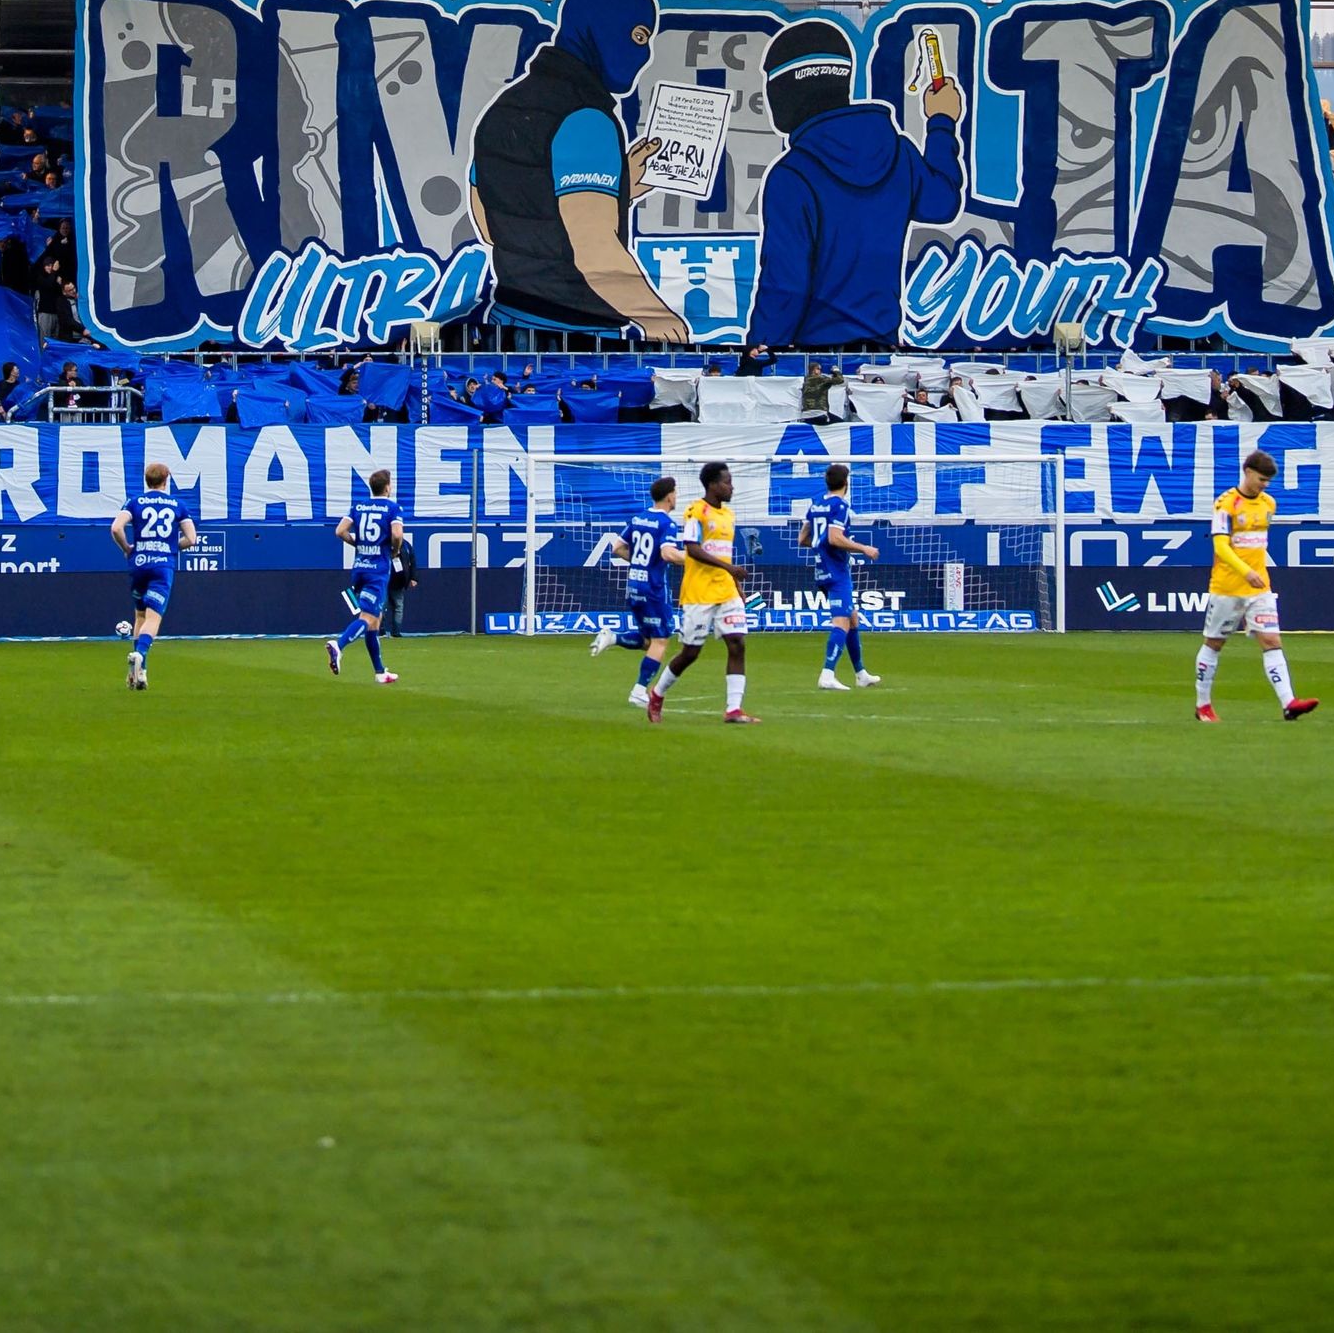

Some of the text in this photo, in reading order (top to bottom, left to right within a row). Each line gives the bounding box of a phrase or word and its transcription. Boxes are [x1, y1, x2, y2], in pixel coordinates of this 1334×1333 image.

[685, 31, 748, 71] FC
[182, 75, 236, 119] LP
[648, 159, 709, 180] ABOVE THE LAW
[240, 243, 488, 351] ULTRA
[902, 243, 1164, 348] YOUTH
[768, 422, 992, 516] AUF
[1041, 422, 1322, 516] EWIG
[137, 496, 178, 507] Oberbank
[140, 506, 175, 538] 23
[359, 512, 382, 542] 15
[631, 530, 654, 567] 29
[774, 590, 906, 611] LIWST
[903, 613, 1034, 629] LINZ AG
